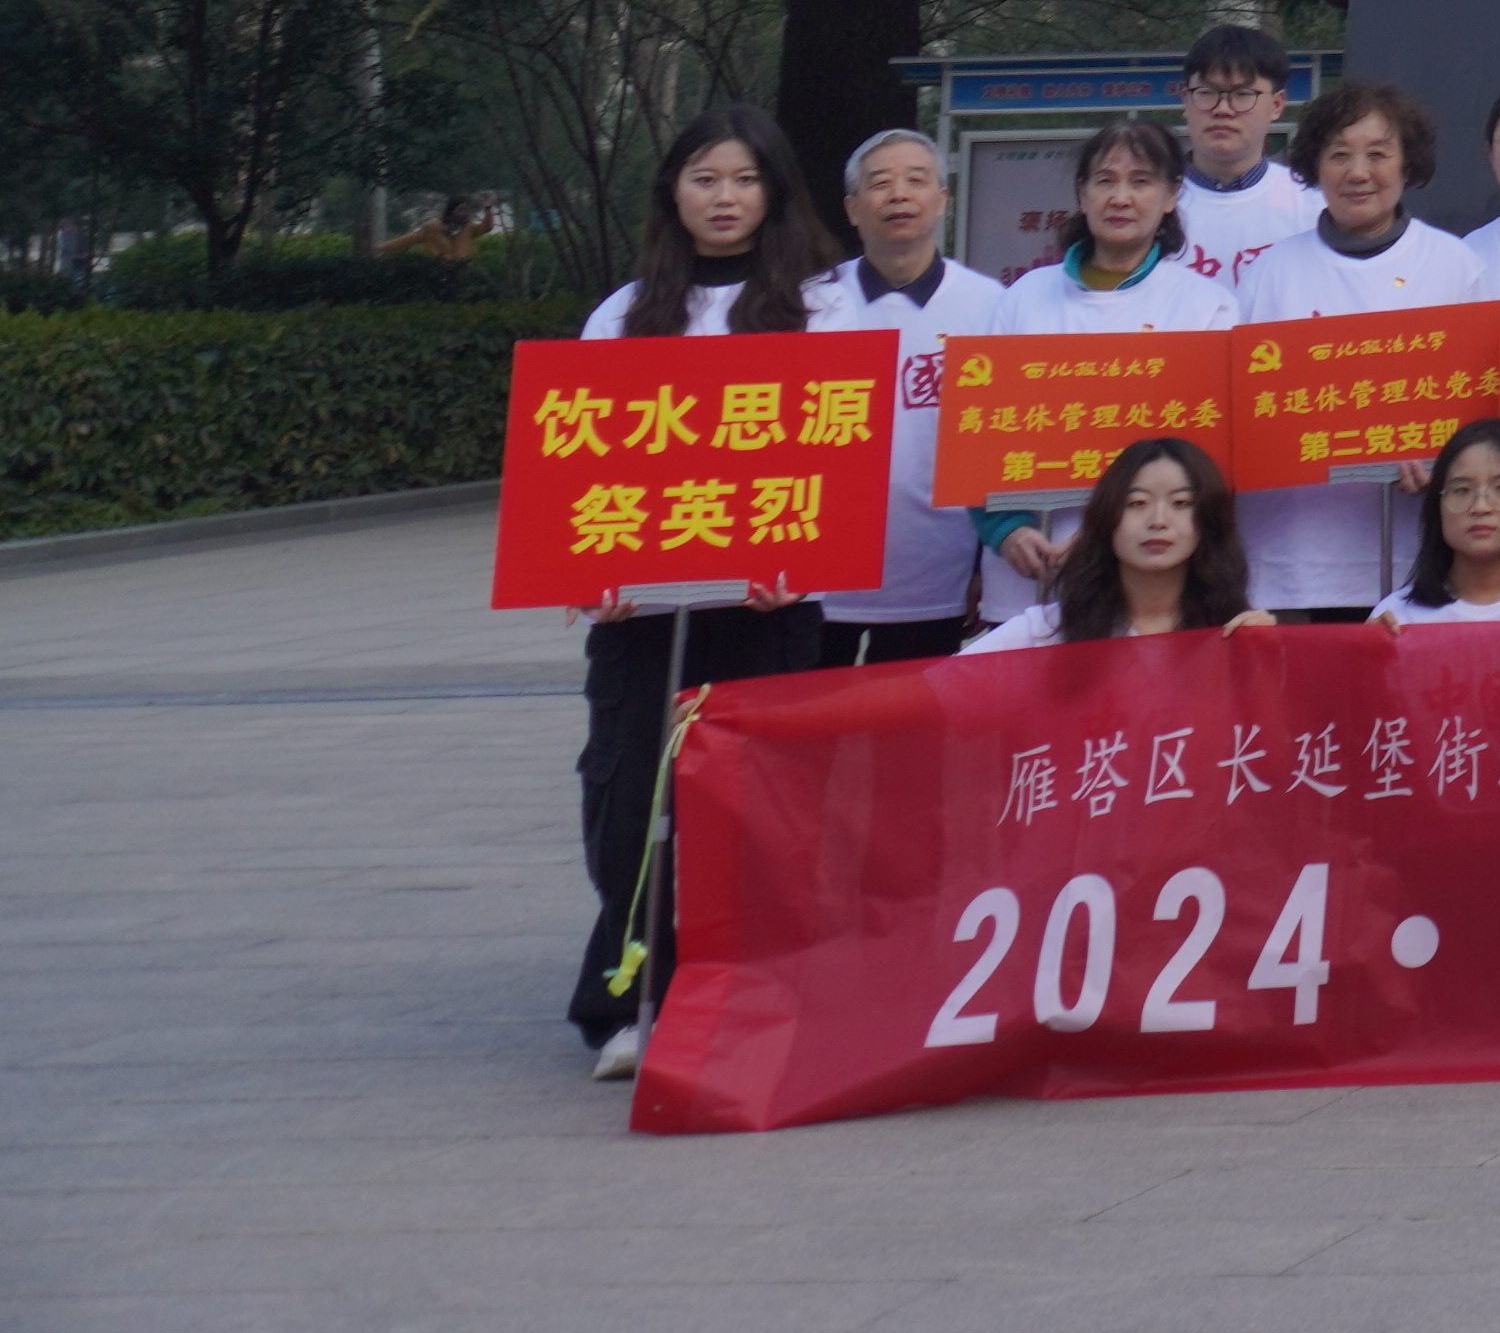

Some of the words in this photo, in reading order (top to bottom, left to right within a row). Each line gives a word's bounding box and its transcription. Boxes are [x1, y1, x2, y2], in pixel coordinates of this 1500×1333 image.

[1308, 330, 1447, 362] 西北政法大学
[1021, 356, 1167, 380] 西北政法大学
[1253, 367, 1500, 419] 离退休管理处党委
[533, 379, 876, 460] 饮水思源
[957, 398, 1222, 434] 离退休管理处党委
[1299, 417, 1459, 463] 第二党支部
[1002, 448, 1126, 482] 第一党
[570, 474, 824, 556] 祭英烈
